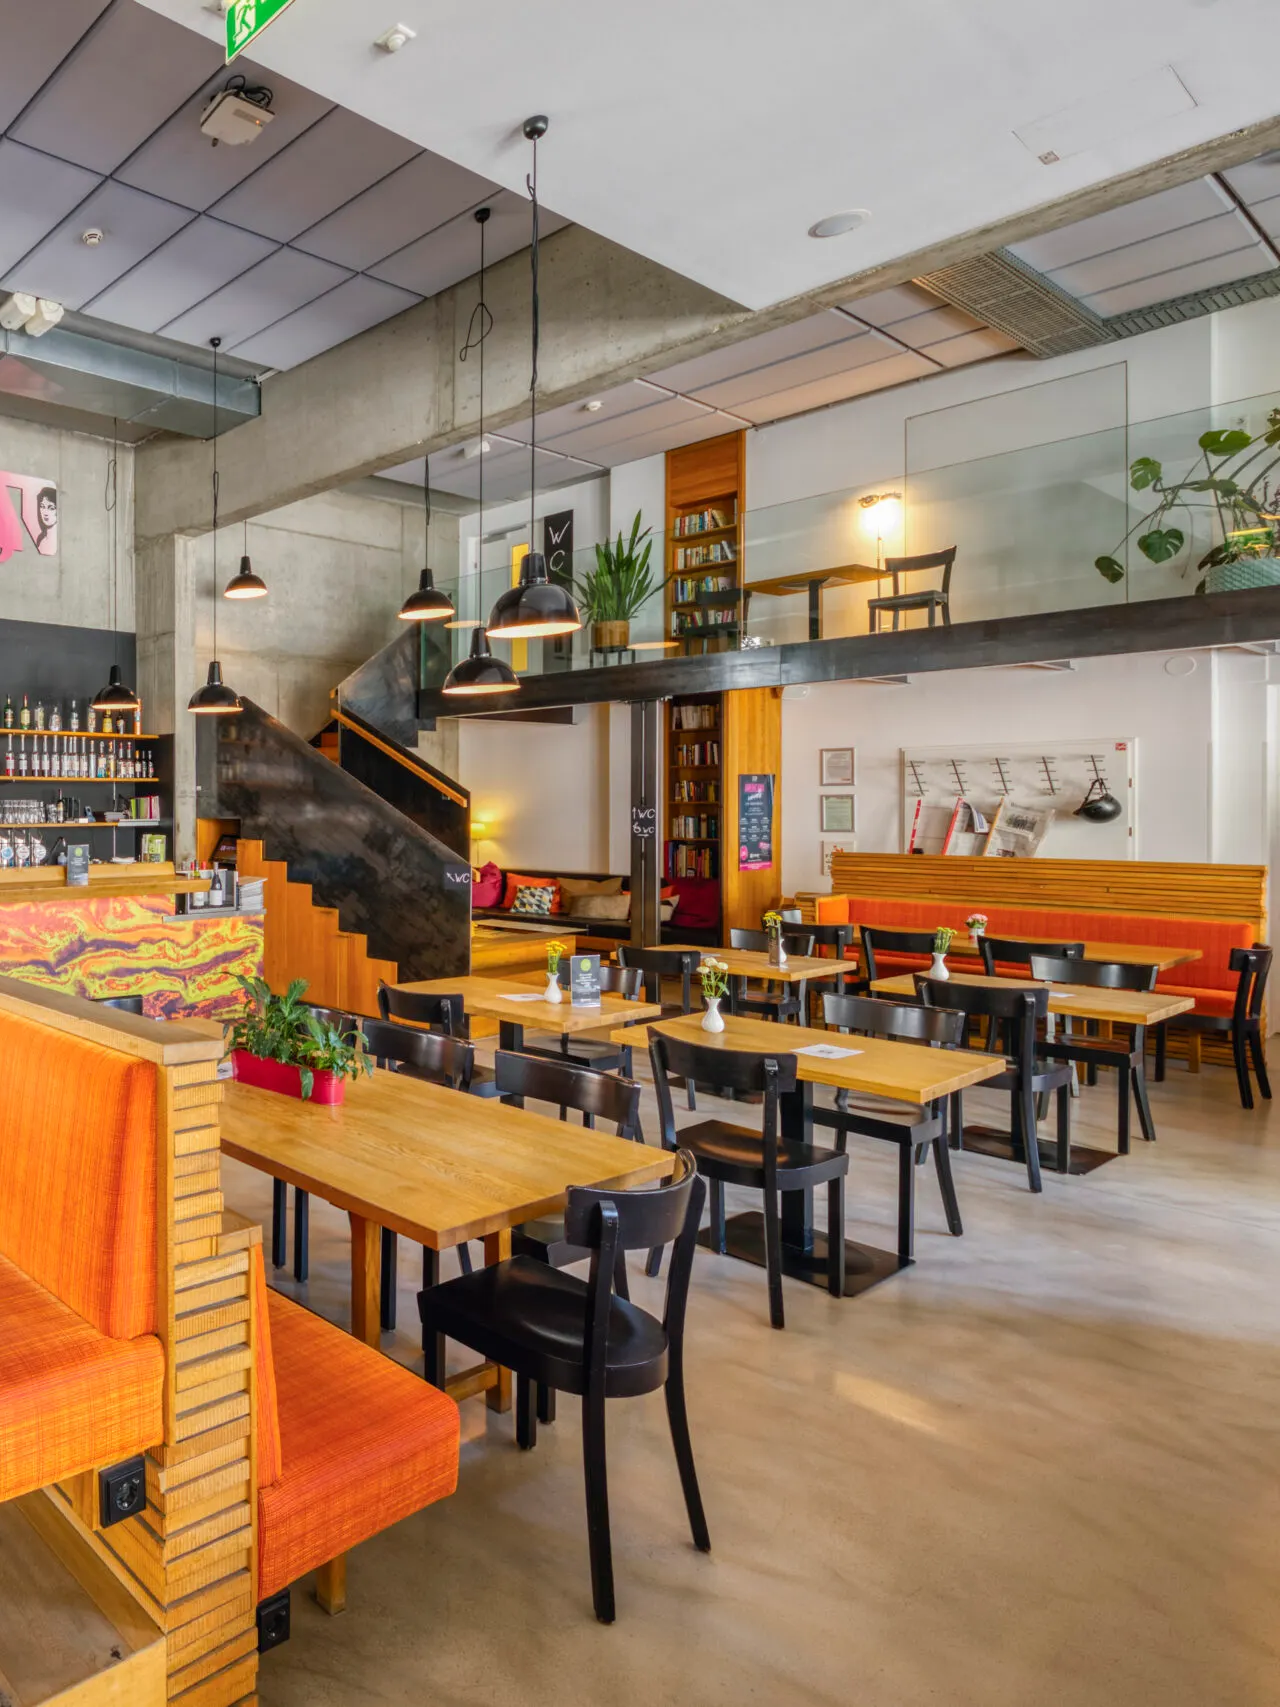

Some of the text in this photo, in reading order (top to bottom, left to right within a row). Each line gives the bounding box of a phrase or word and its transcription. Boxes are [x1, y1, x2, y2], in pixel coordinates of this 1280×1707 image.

[549, 520, 570, 571] WC
[637, 808, 656, 819] WC
[455, 872, 470, 883] WC
